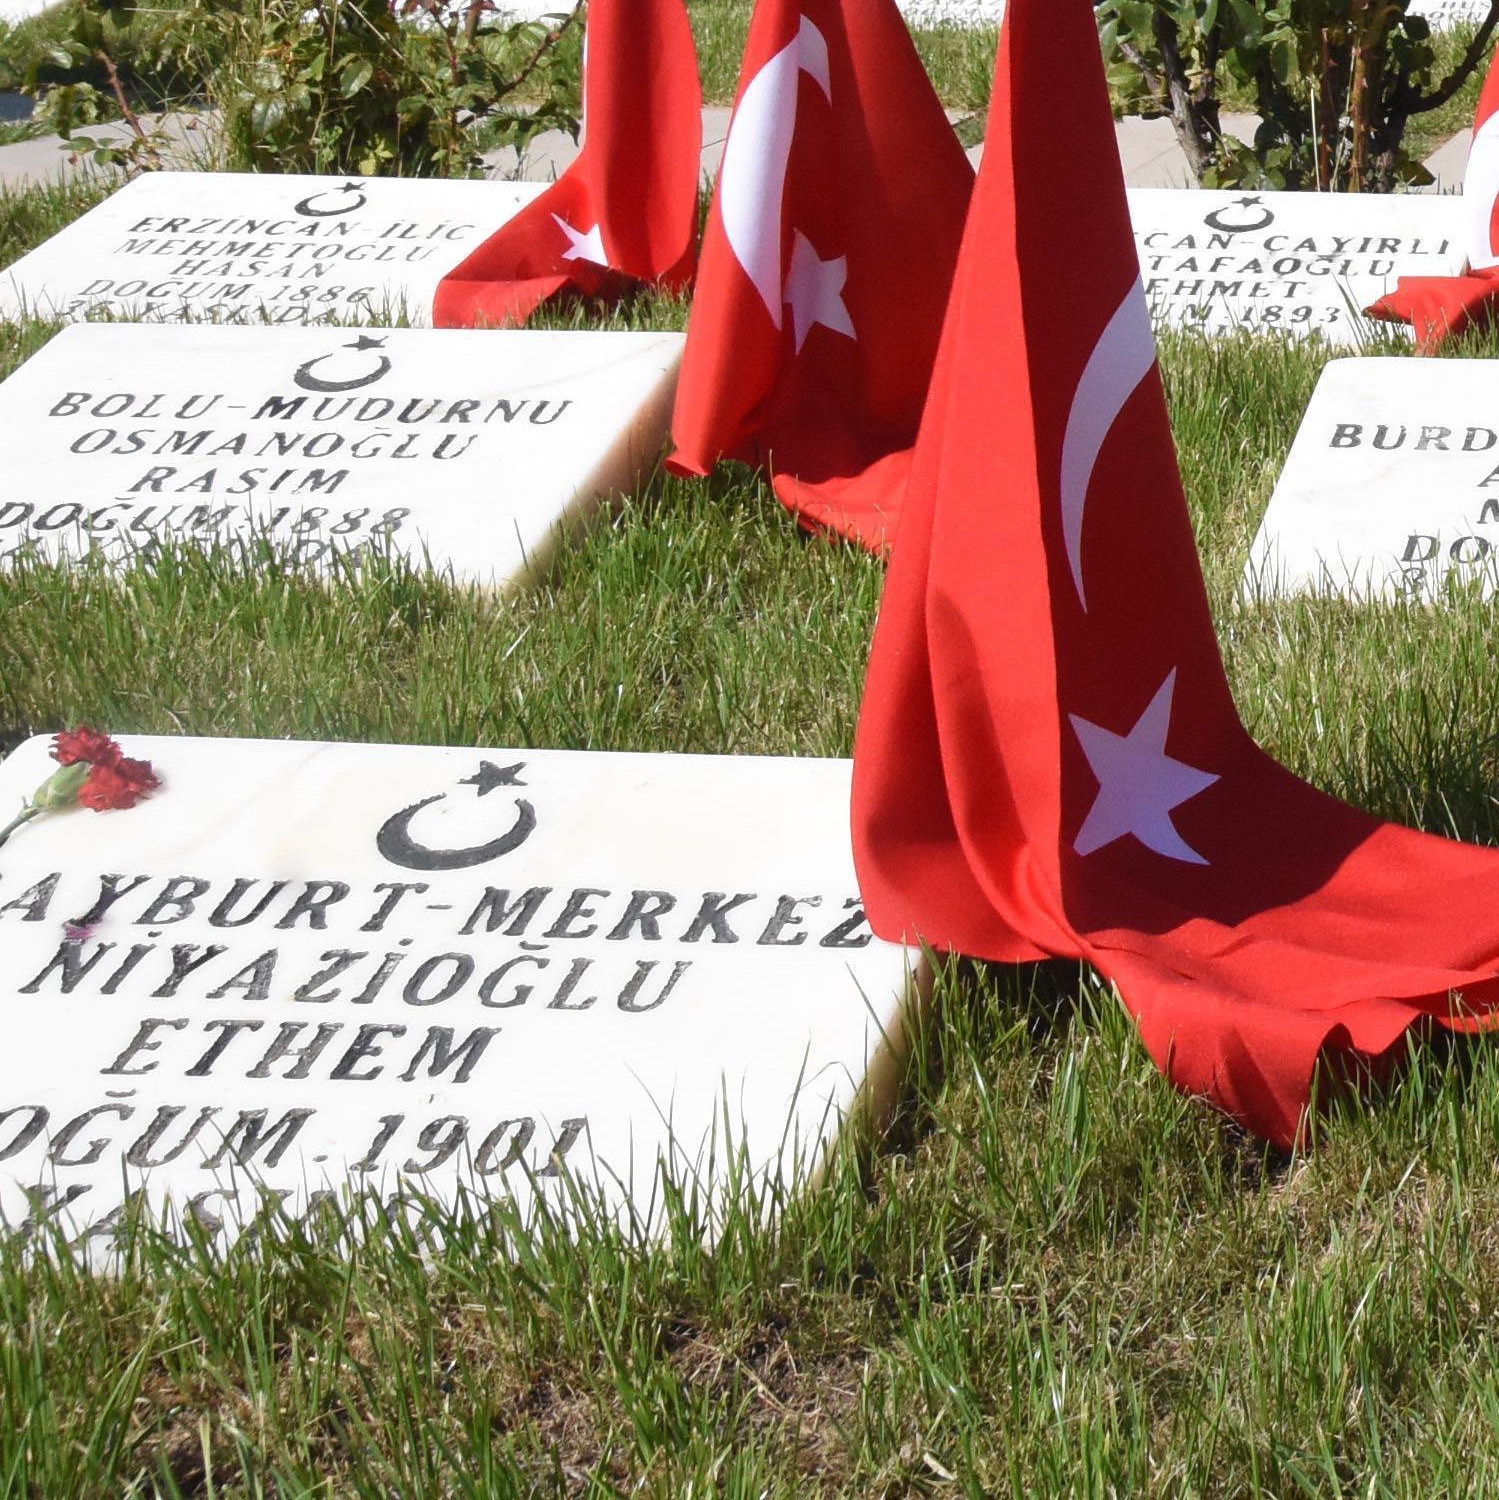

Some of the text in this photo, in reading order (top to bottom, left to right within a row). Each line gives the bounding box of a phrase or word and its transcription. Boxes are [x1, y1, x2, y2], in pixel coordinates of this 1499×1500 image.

[168, 259, 336, 279] HASAN
[1146, 253, 1395, 277] TAFAOĞLU
[1144, 277, 1308, 299] EHMET
[69, 425, 479, 461] OSMANOĞLU
[0, 870, 877, 950] AYBURT-MERKEZ
[17, 930, 694, 1014] NİYAZİOĞLU
[100, 1016, 503, 1084] ETHEM
